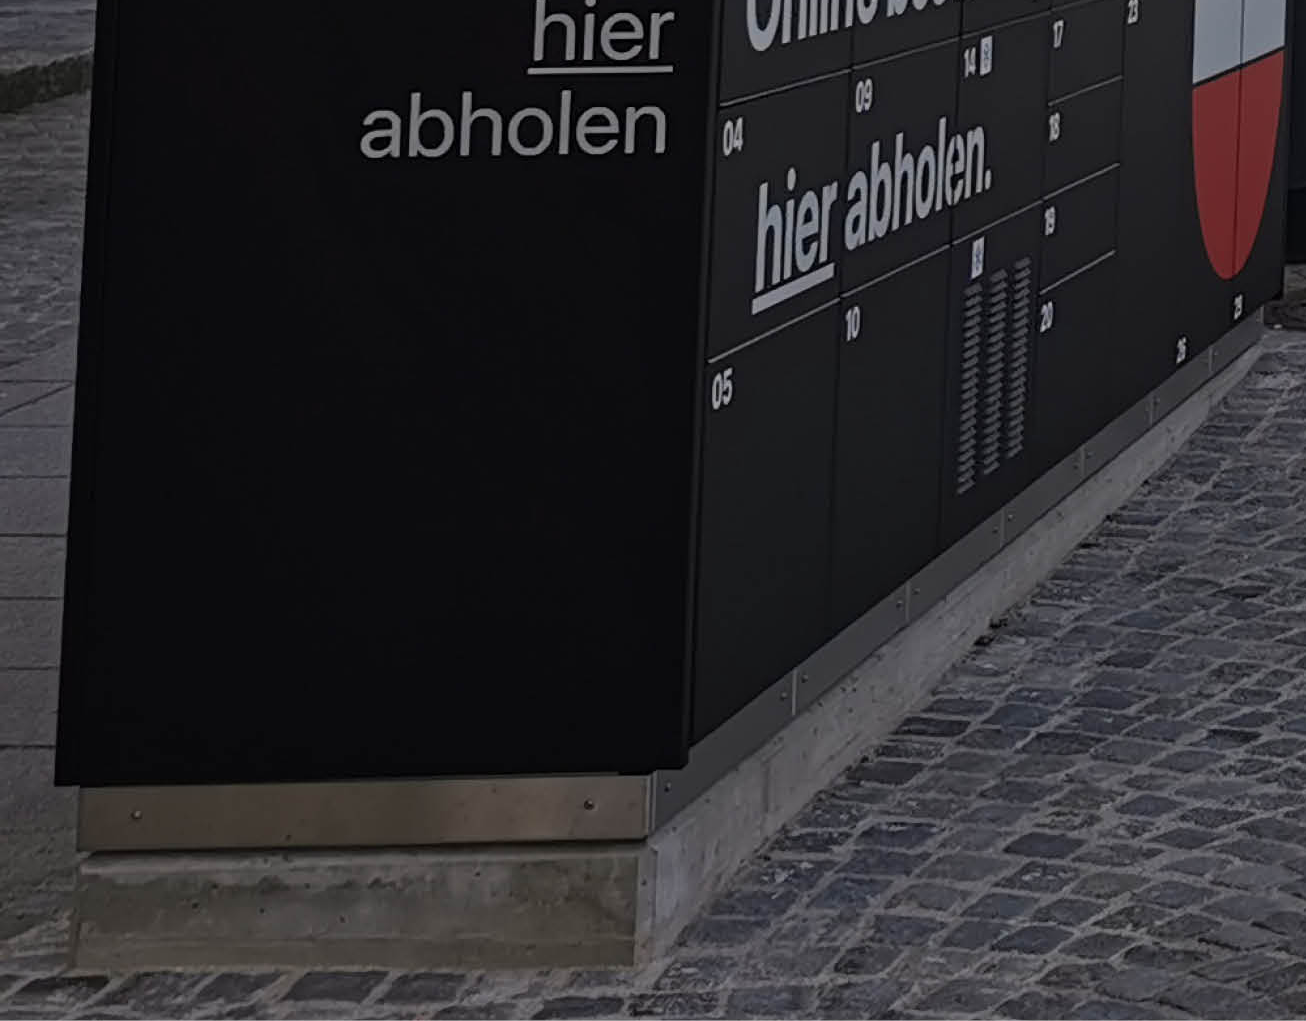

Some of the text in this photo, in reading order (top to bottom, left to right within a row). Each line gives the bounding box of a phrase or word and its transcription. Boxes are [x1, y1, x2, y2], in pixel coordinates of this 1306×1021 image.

[1053, 20, 1065, 48] 17
[963, 46, 977, 78] 14
[855, 79, 873, 113] 09
[359, 89, 666, 159] abholen
[723, 117, 744, 156] 04
[1049, 112, 1061, 141] 18
[754, 117, 993, 293] hier abholen.
[845, 306, 861, 341] 10
[1040, 300, 1054, 333] 20
[711, 367, 734, 410] 05
